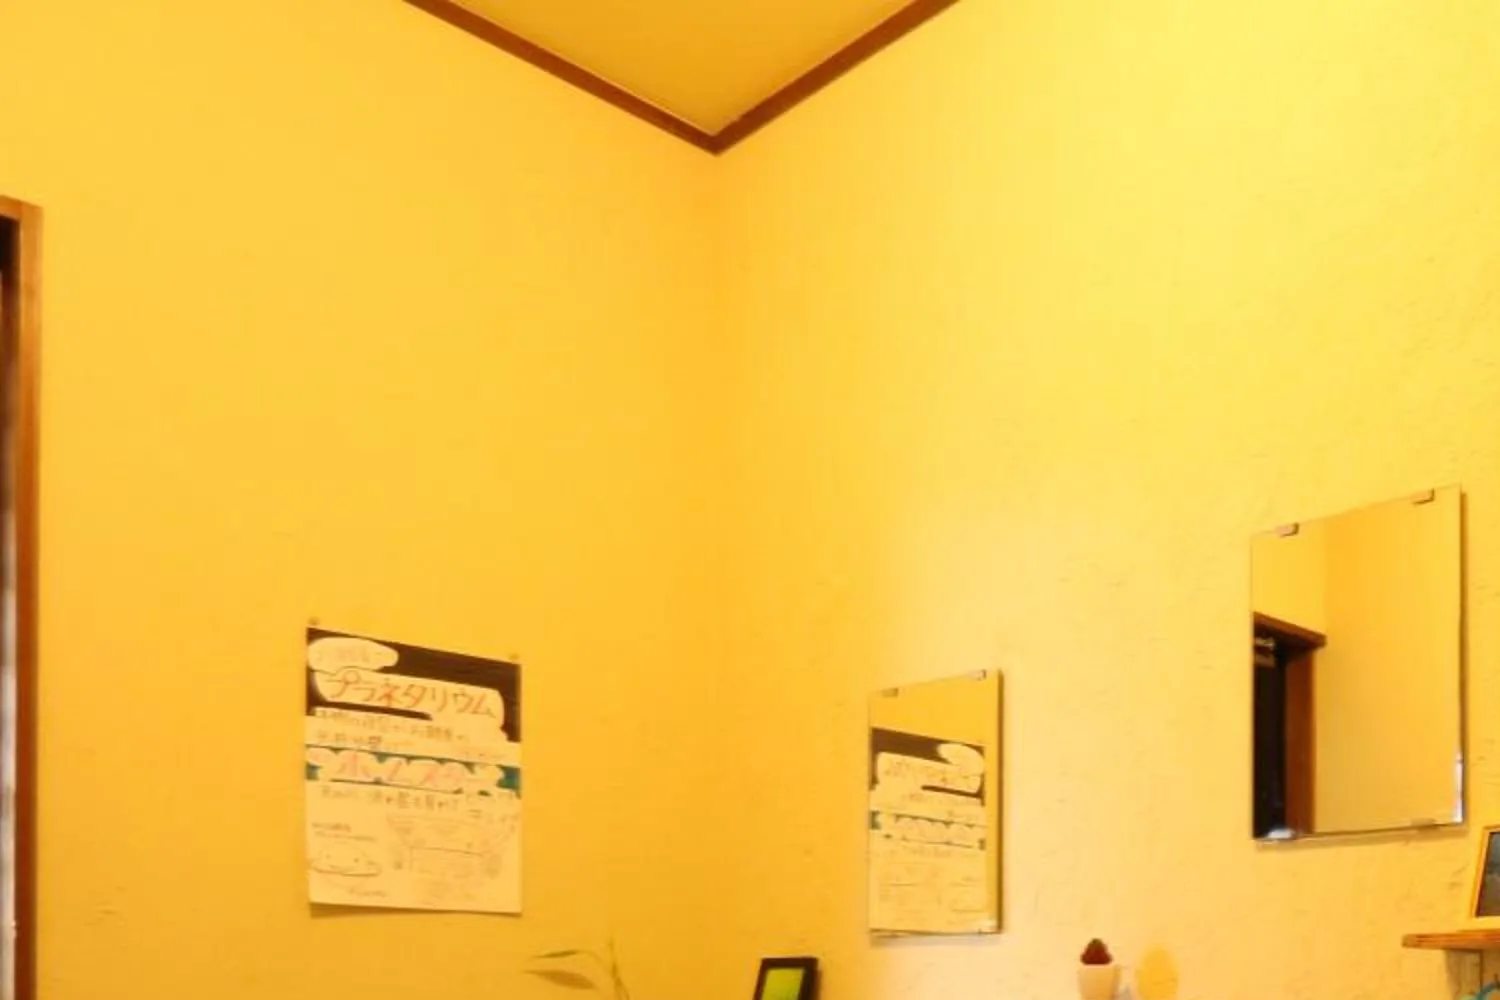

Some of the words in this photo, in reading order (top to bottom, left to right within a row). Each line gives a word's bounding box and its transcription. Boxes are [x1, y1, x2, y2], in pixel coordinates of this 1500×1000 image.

[325, 669, 496, 719] プラネタリウム
